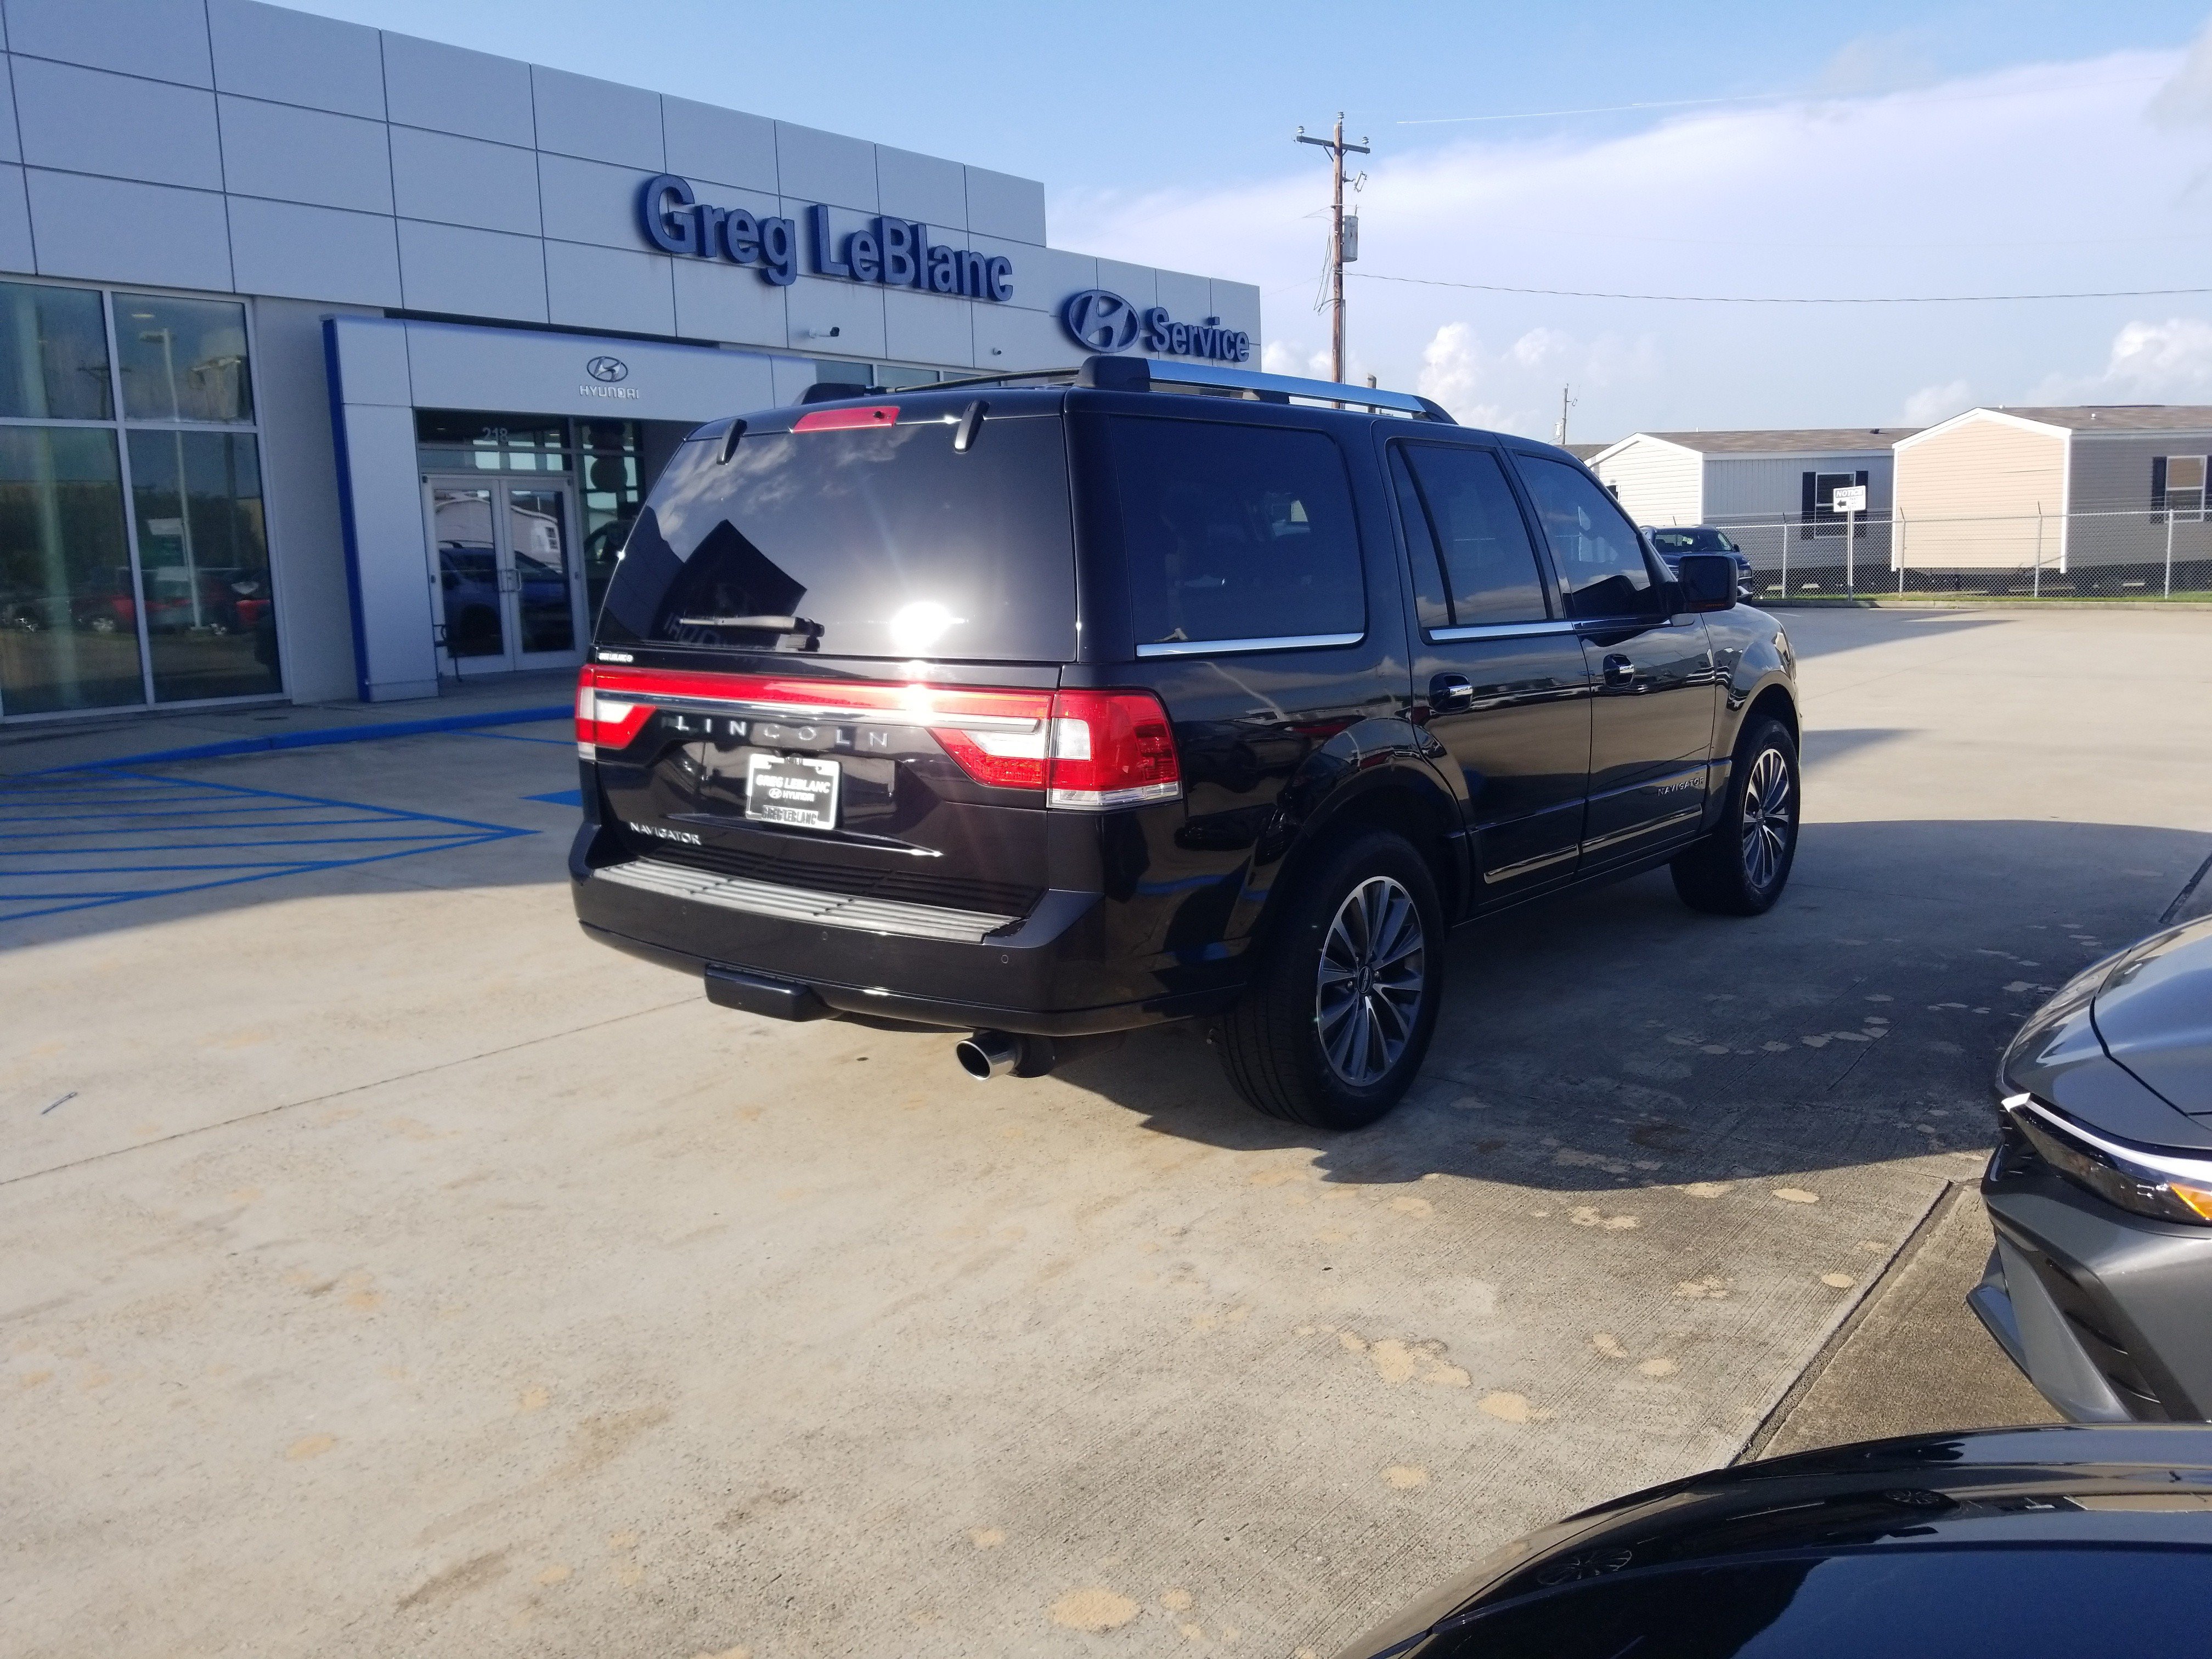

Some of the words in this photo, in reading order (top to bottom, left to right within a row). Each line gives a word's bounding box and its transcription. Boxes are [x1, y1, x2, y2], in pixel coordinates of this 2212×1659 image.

[642, 174, 797, 286] Greg
[811, 204, 1013, 301] LeBlanc
[1149, 307, 1250, 362] Service
[579, 385, 639, 399] HYUNDAI
[482, 427, 508, 442] 218
[1836, 488, 1863, 498] NOTICE
[676, 715, 889, 748] LINCOLN
[756, 774, 784, 788] GREG
[784, 777, 831, 794] LEBLANC
[1657, 776, 1705, 797] NAVIGATOR
[783, 807, 817, 825] LEBLANC
[630, 822, 702, 846] NAVIGATOR
